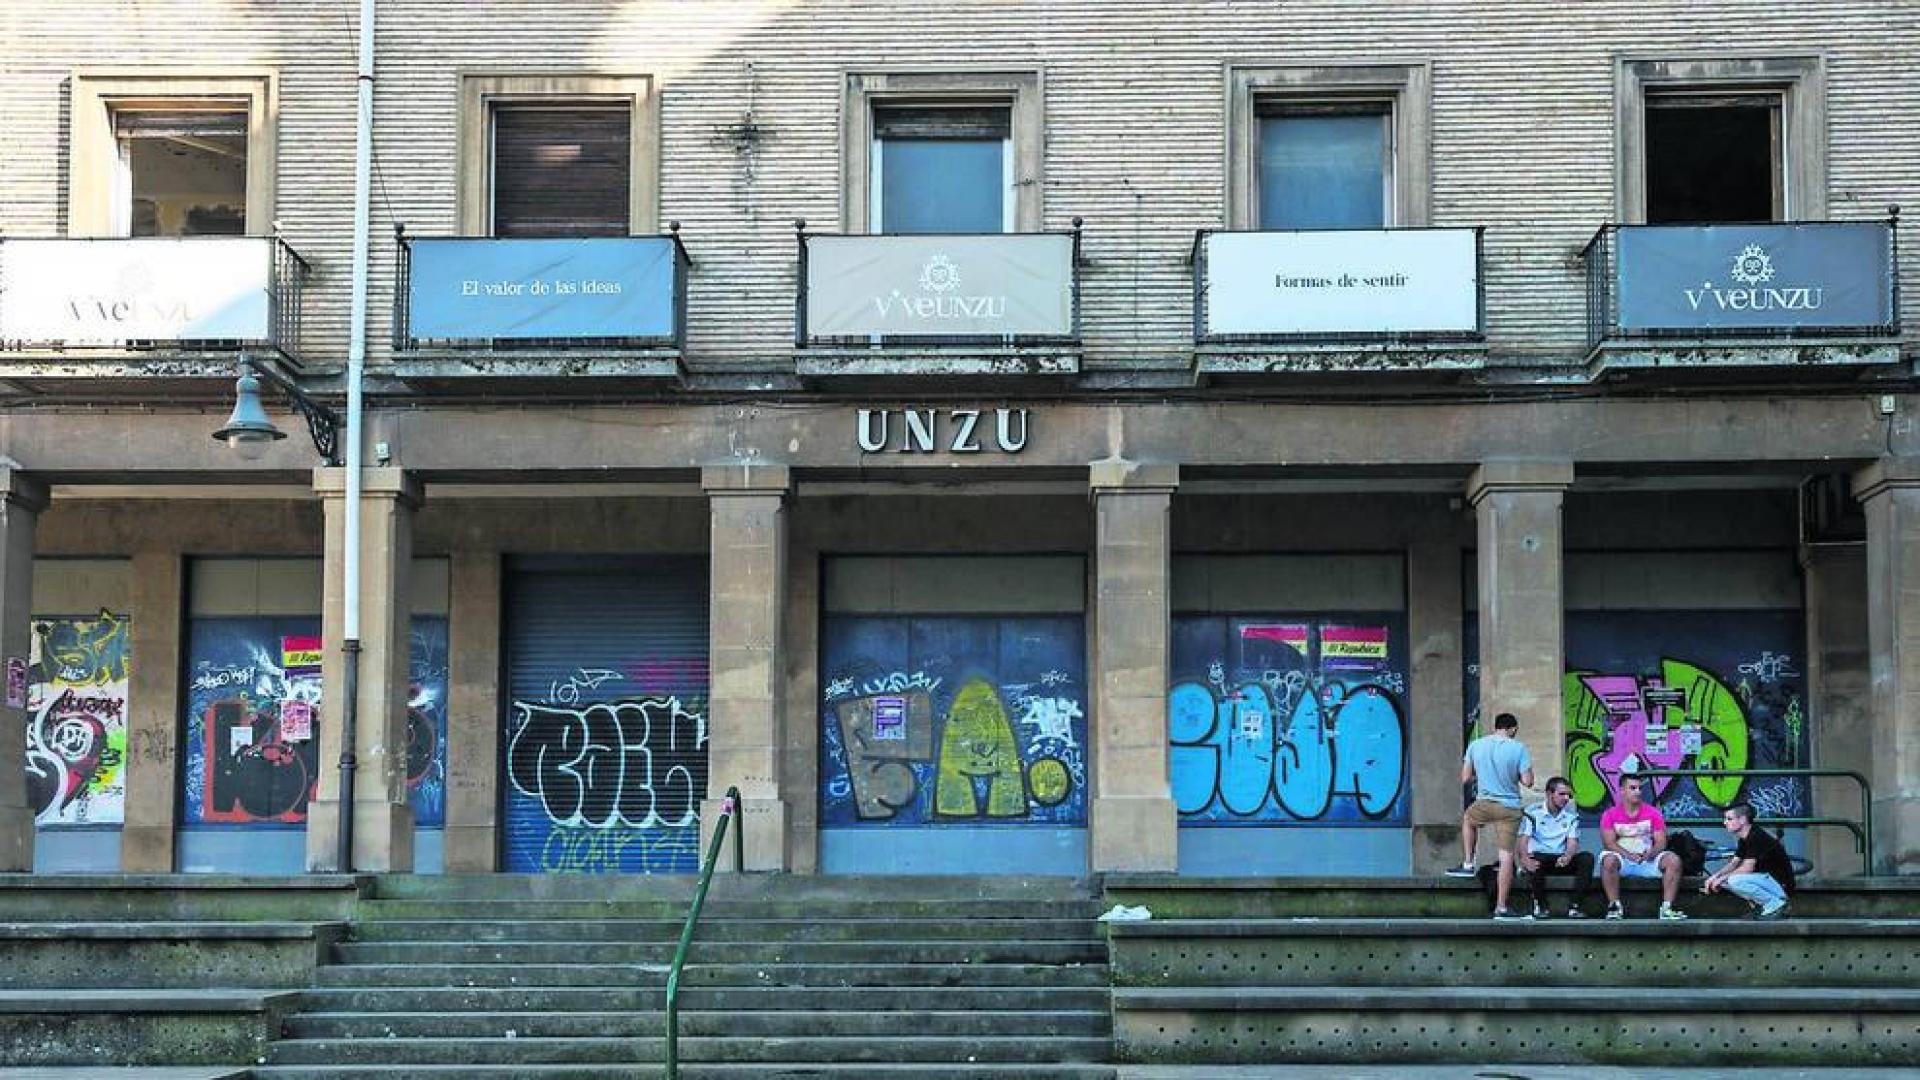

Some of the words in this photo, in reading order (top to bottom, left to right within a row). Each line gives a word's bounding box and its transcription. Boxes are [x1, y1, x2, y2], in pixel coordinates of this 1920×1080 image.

[461, 280, 479, 296] El
[484, 280, 527, 296] valor
[530, 280, 550, 296] de
[555, 279, 577, 295] las
[582, 278, 622, 295] ideas
[1275, 274, 1333, 288] Formas
[1337, 273, 1359, 288] de
[1363, 272, 1410, 287] sentir
[857, 408, 1028, 453] UNZU
